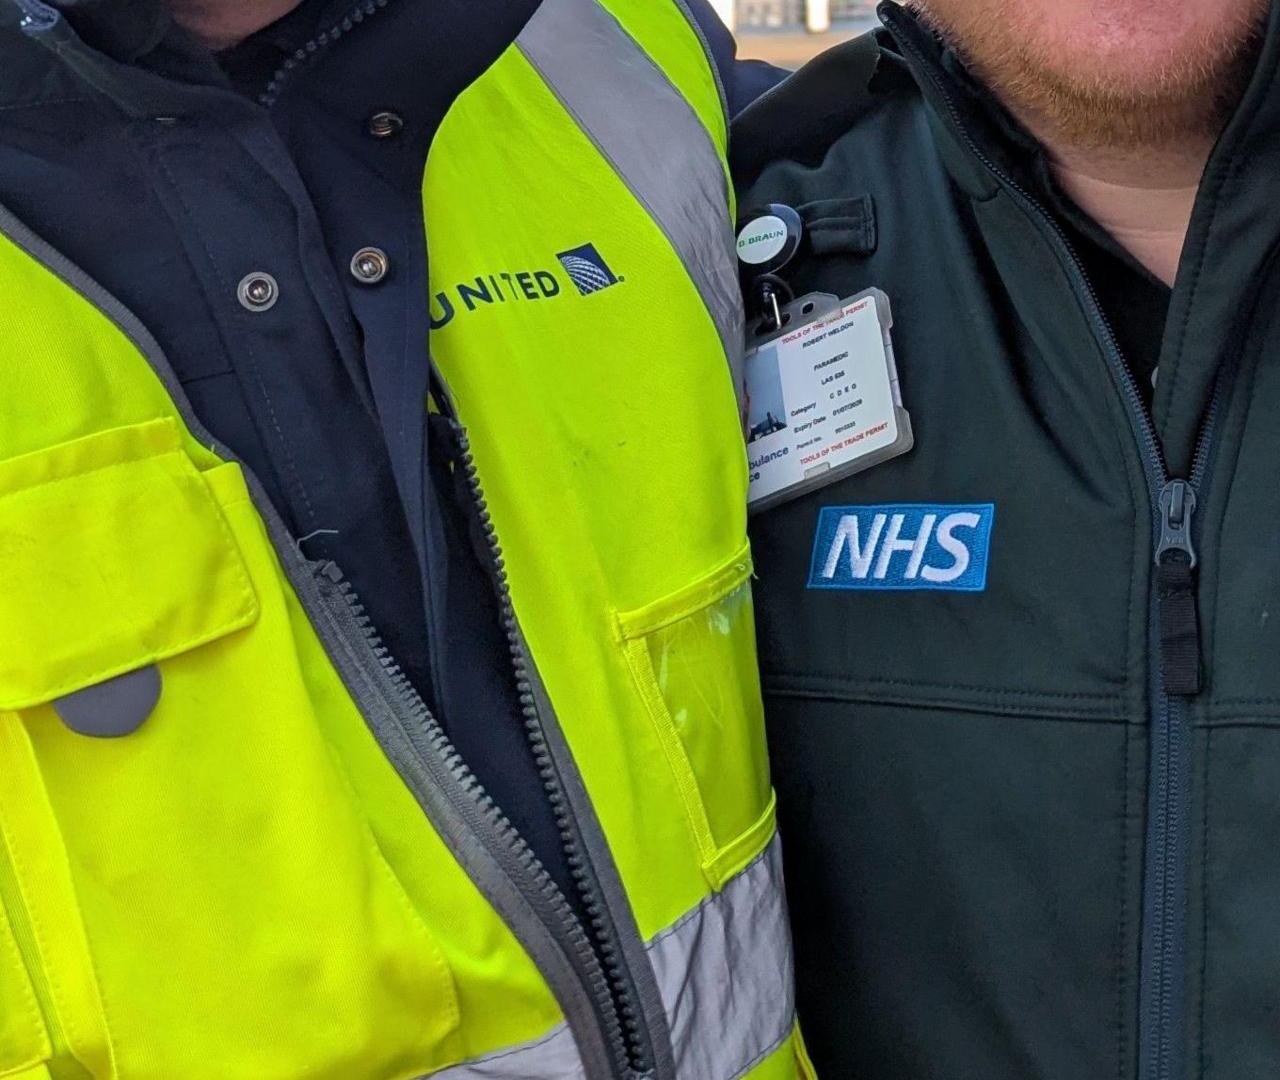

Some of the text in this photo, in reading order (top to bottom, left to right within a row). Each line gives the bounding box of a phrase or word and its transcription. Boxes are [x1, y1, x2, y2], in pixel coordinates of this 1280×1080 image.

[748, 229, 784, 245] BRAUN
[429, 270, 561, 330] UNITED
[802, 332, 827, 348] ROBERT
[813, 351, 849, 371] PARAMEDIC
[791, 402, 817, 417] Category
[821, 511, 981, 584] NHS
